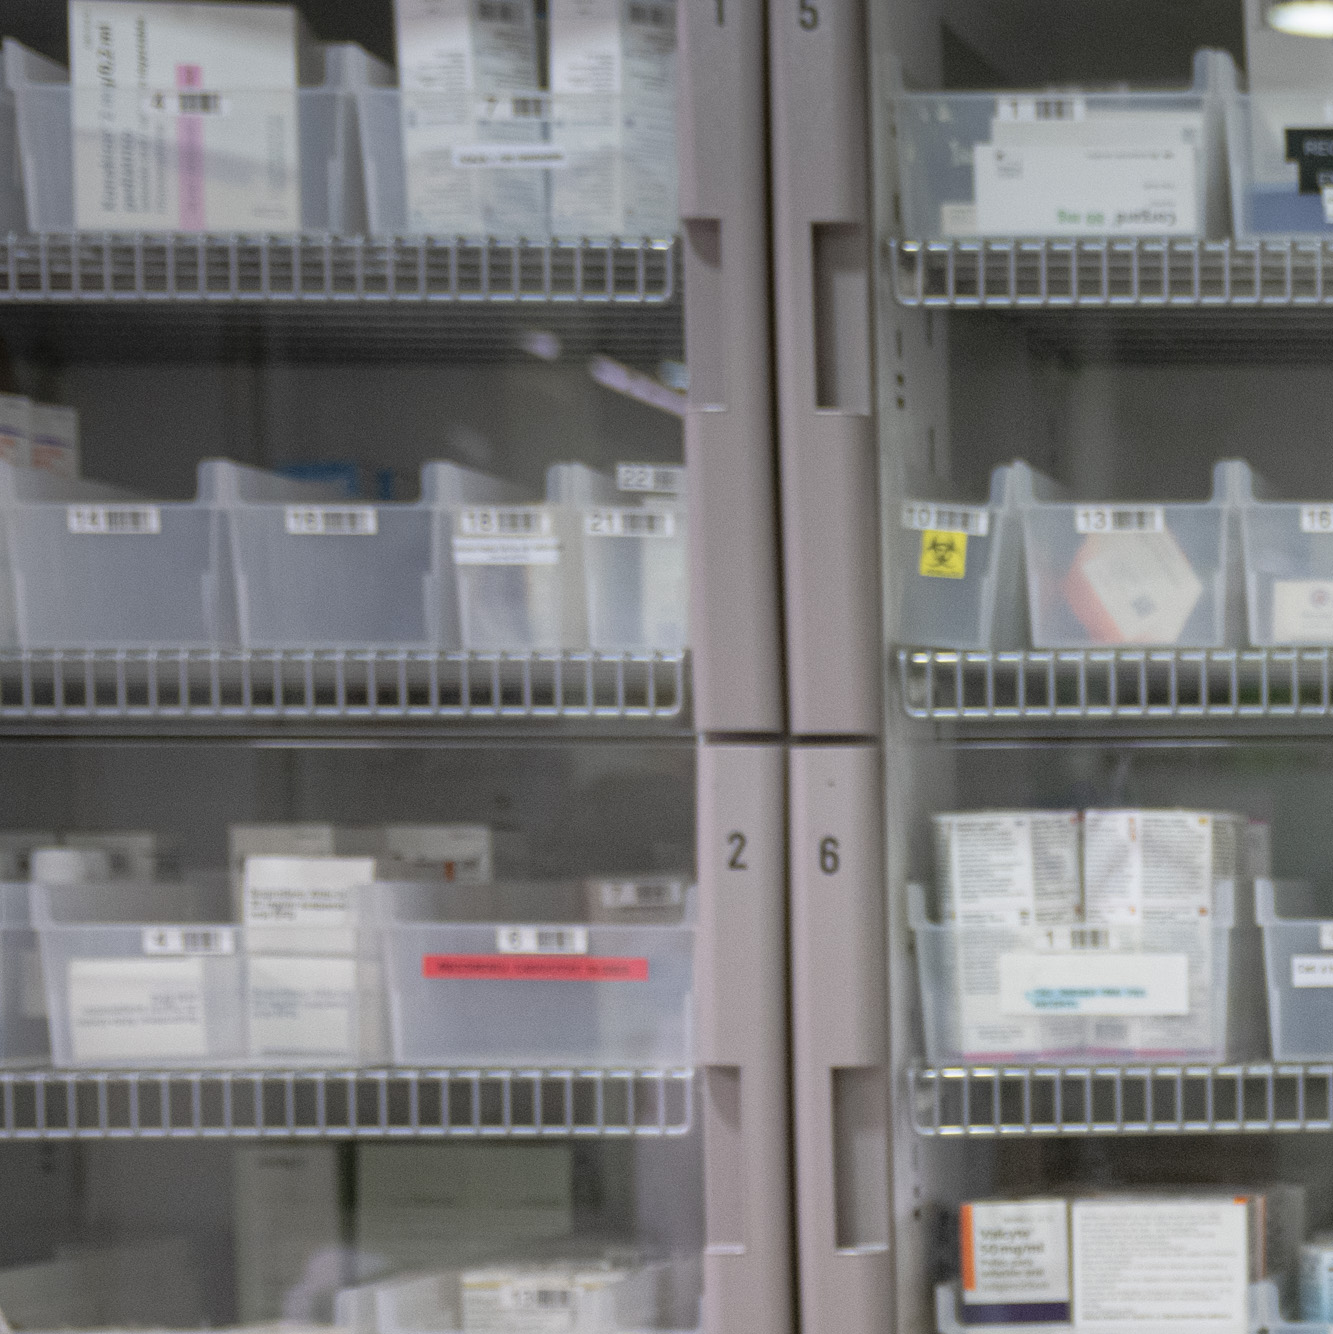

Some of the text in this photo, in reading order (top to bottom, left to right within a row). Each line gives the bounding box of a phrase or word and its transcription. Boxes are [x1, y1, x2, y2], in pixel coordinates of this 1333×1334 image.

[797, 0, 820, 31] 5
[622, 470, 650, 486] 22
[1081, 510, 1107, 529] 13
[727, 833, 748, 870] 2
[819, 836, 840, 874] 6
